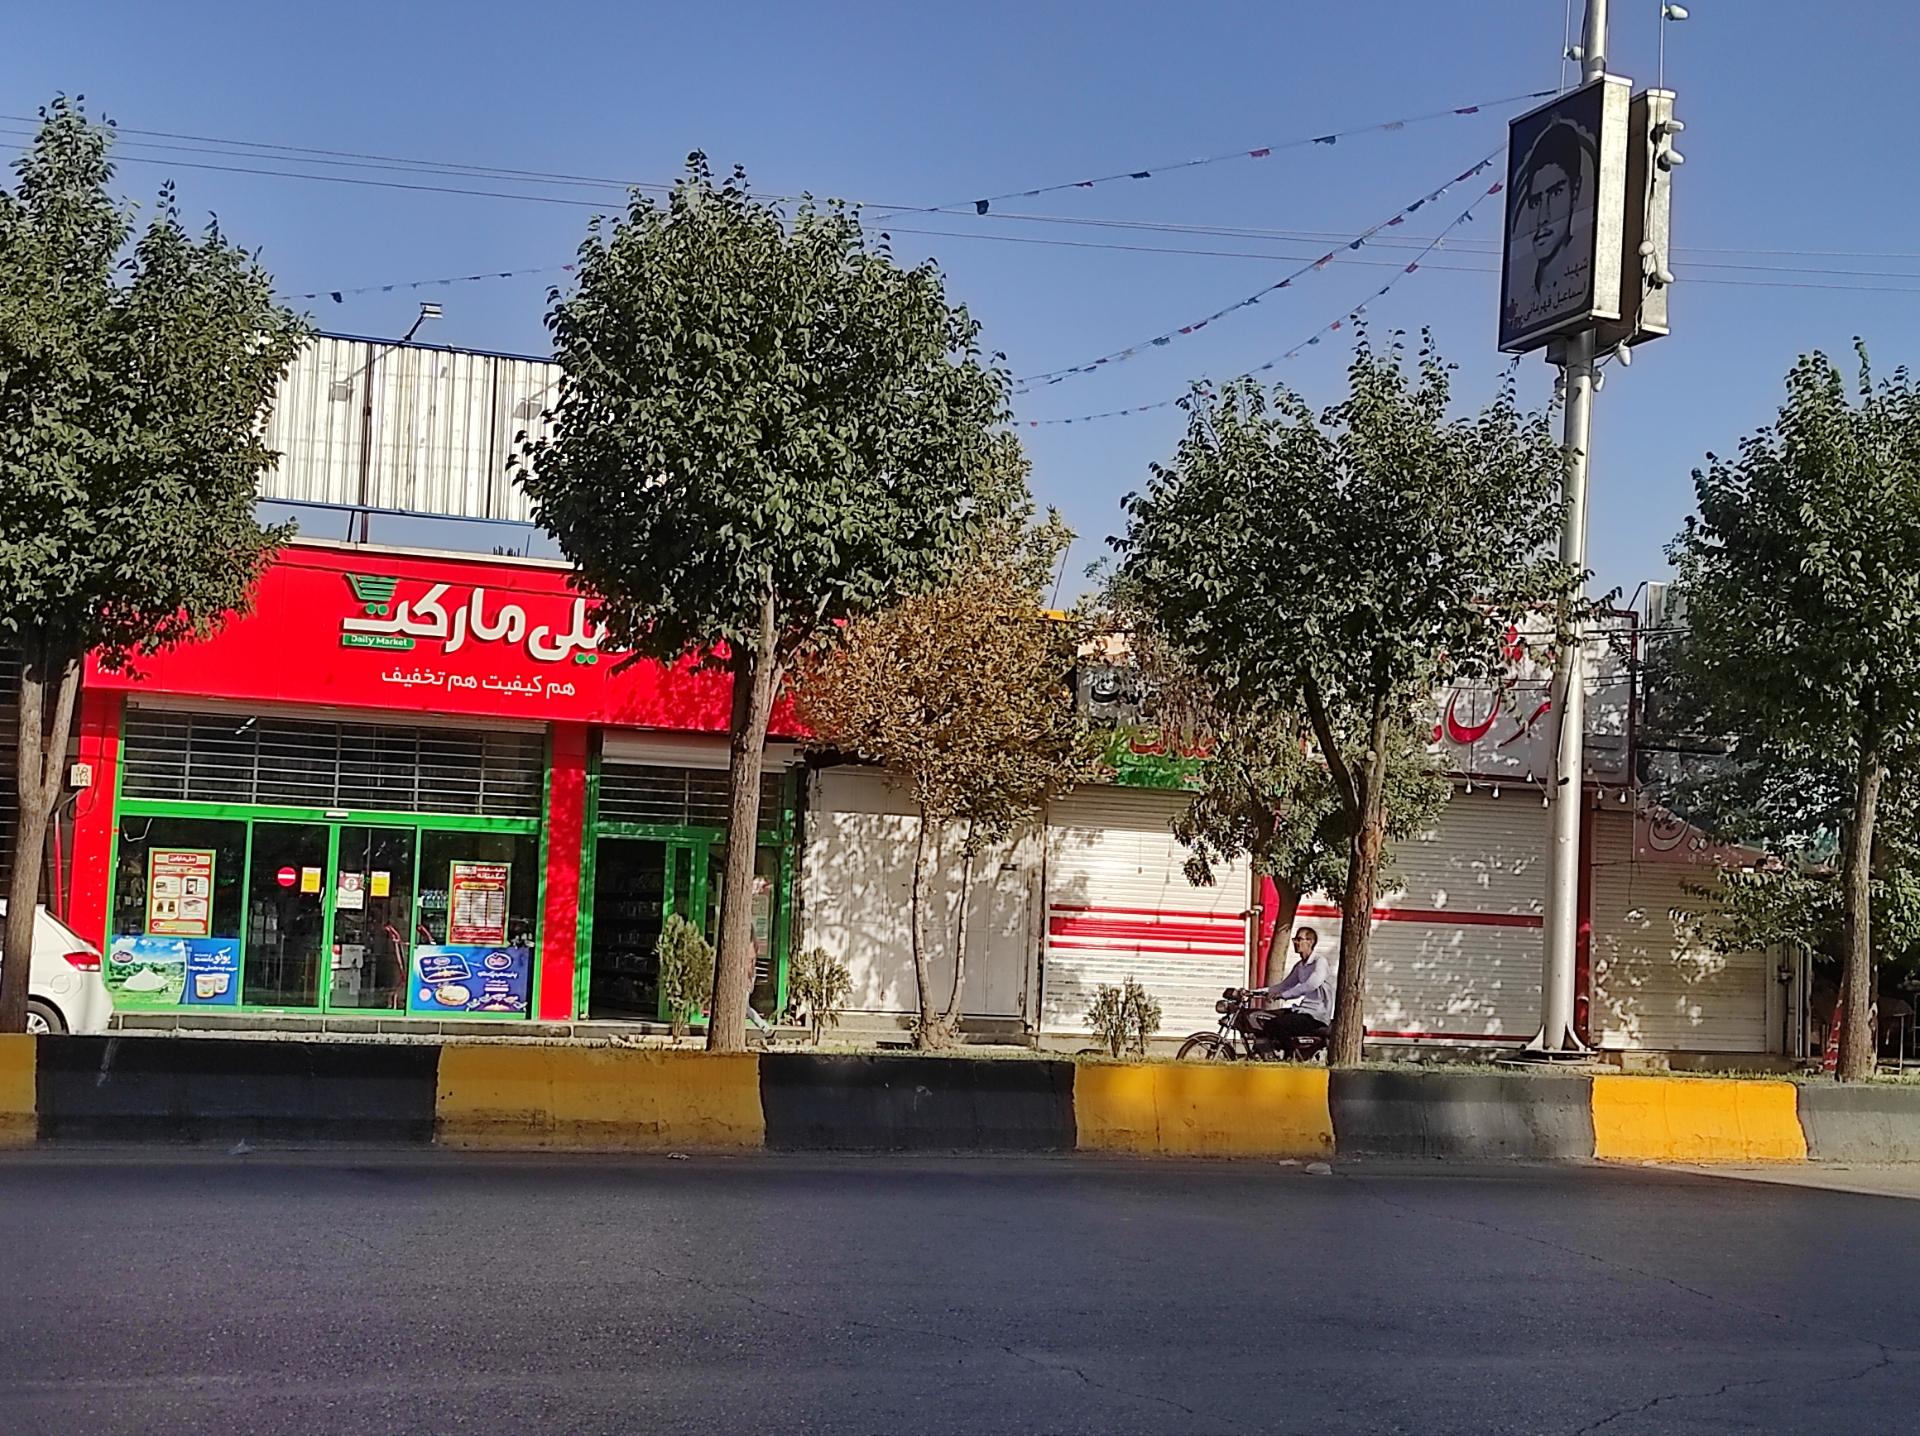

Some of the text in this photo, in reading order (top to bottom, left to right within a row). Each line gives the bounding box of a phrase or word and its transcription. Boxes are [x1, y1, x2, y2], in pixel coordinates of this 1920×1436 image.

[1564, 257, 1588, 279] شهید
[1553, 282, 1587, 309] اسماعیل
[343, 583, 632, 665] یلی مارکت
[351, 635, 408, 647] Daily Market
[381, 668, 575, 698] هم کیفیت هم تخفیف
